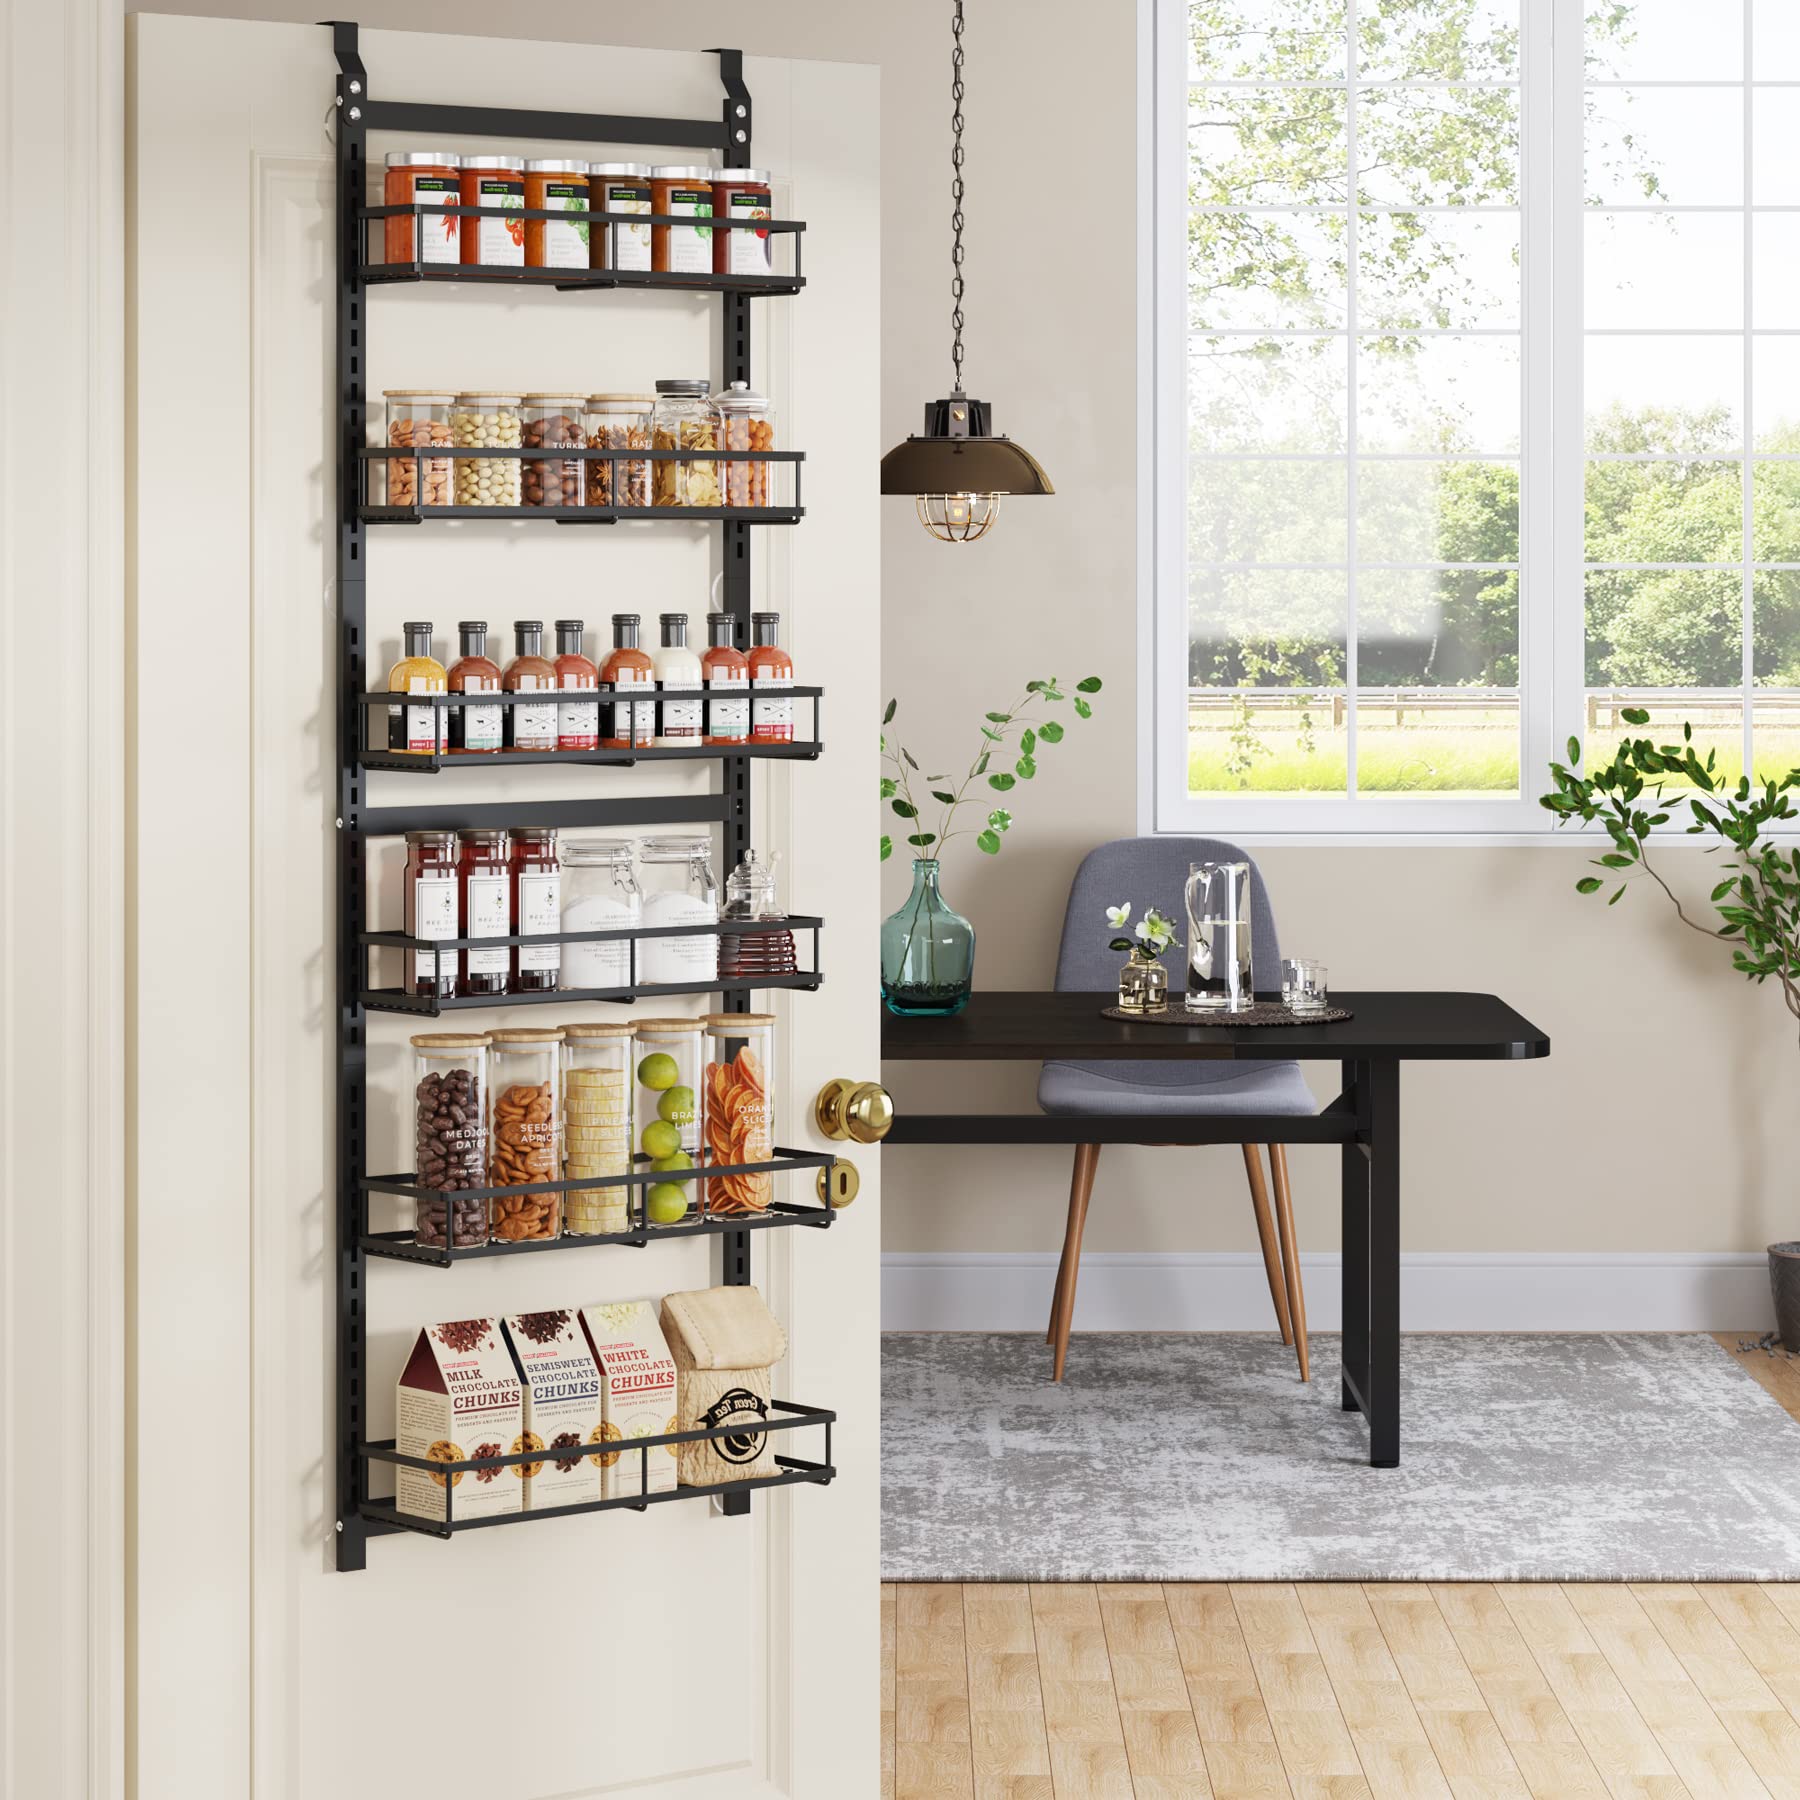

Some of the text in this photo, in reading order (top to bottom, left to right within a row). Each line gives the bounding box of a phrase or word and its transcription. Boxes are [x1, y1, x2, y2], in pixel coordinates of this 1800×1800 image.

[456, 1139, 486, 1150] DATES
[603, 1349, 649, 1363] WHITE
[526, 1357, 592, 1373] SEMISWEET
[608, 1360, 674, 1375] CHOCOLATE
[446, 1369, 483, 1383] MILK
[531, 1368, 597, 1385] CHOCOLATE
[611, 1371, 675, 1389] CHUNKS
[451, 1378, 519, 1394] CHOCOLATE
[533, 1380, 599, 1399] CHUNKS
[453, 1390, 520, 1409] CHUNKS
